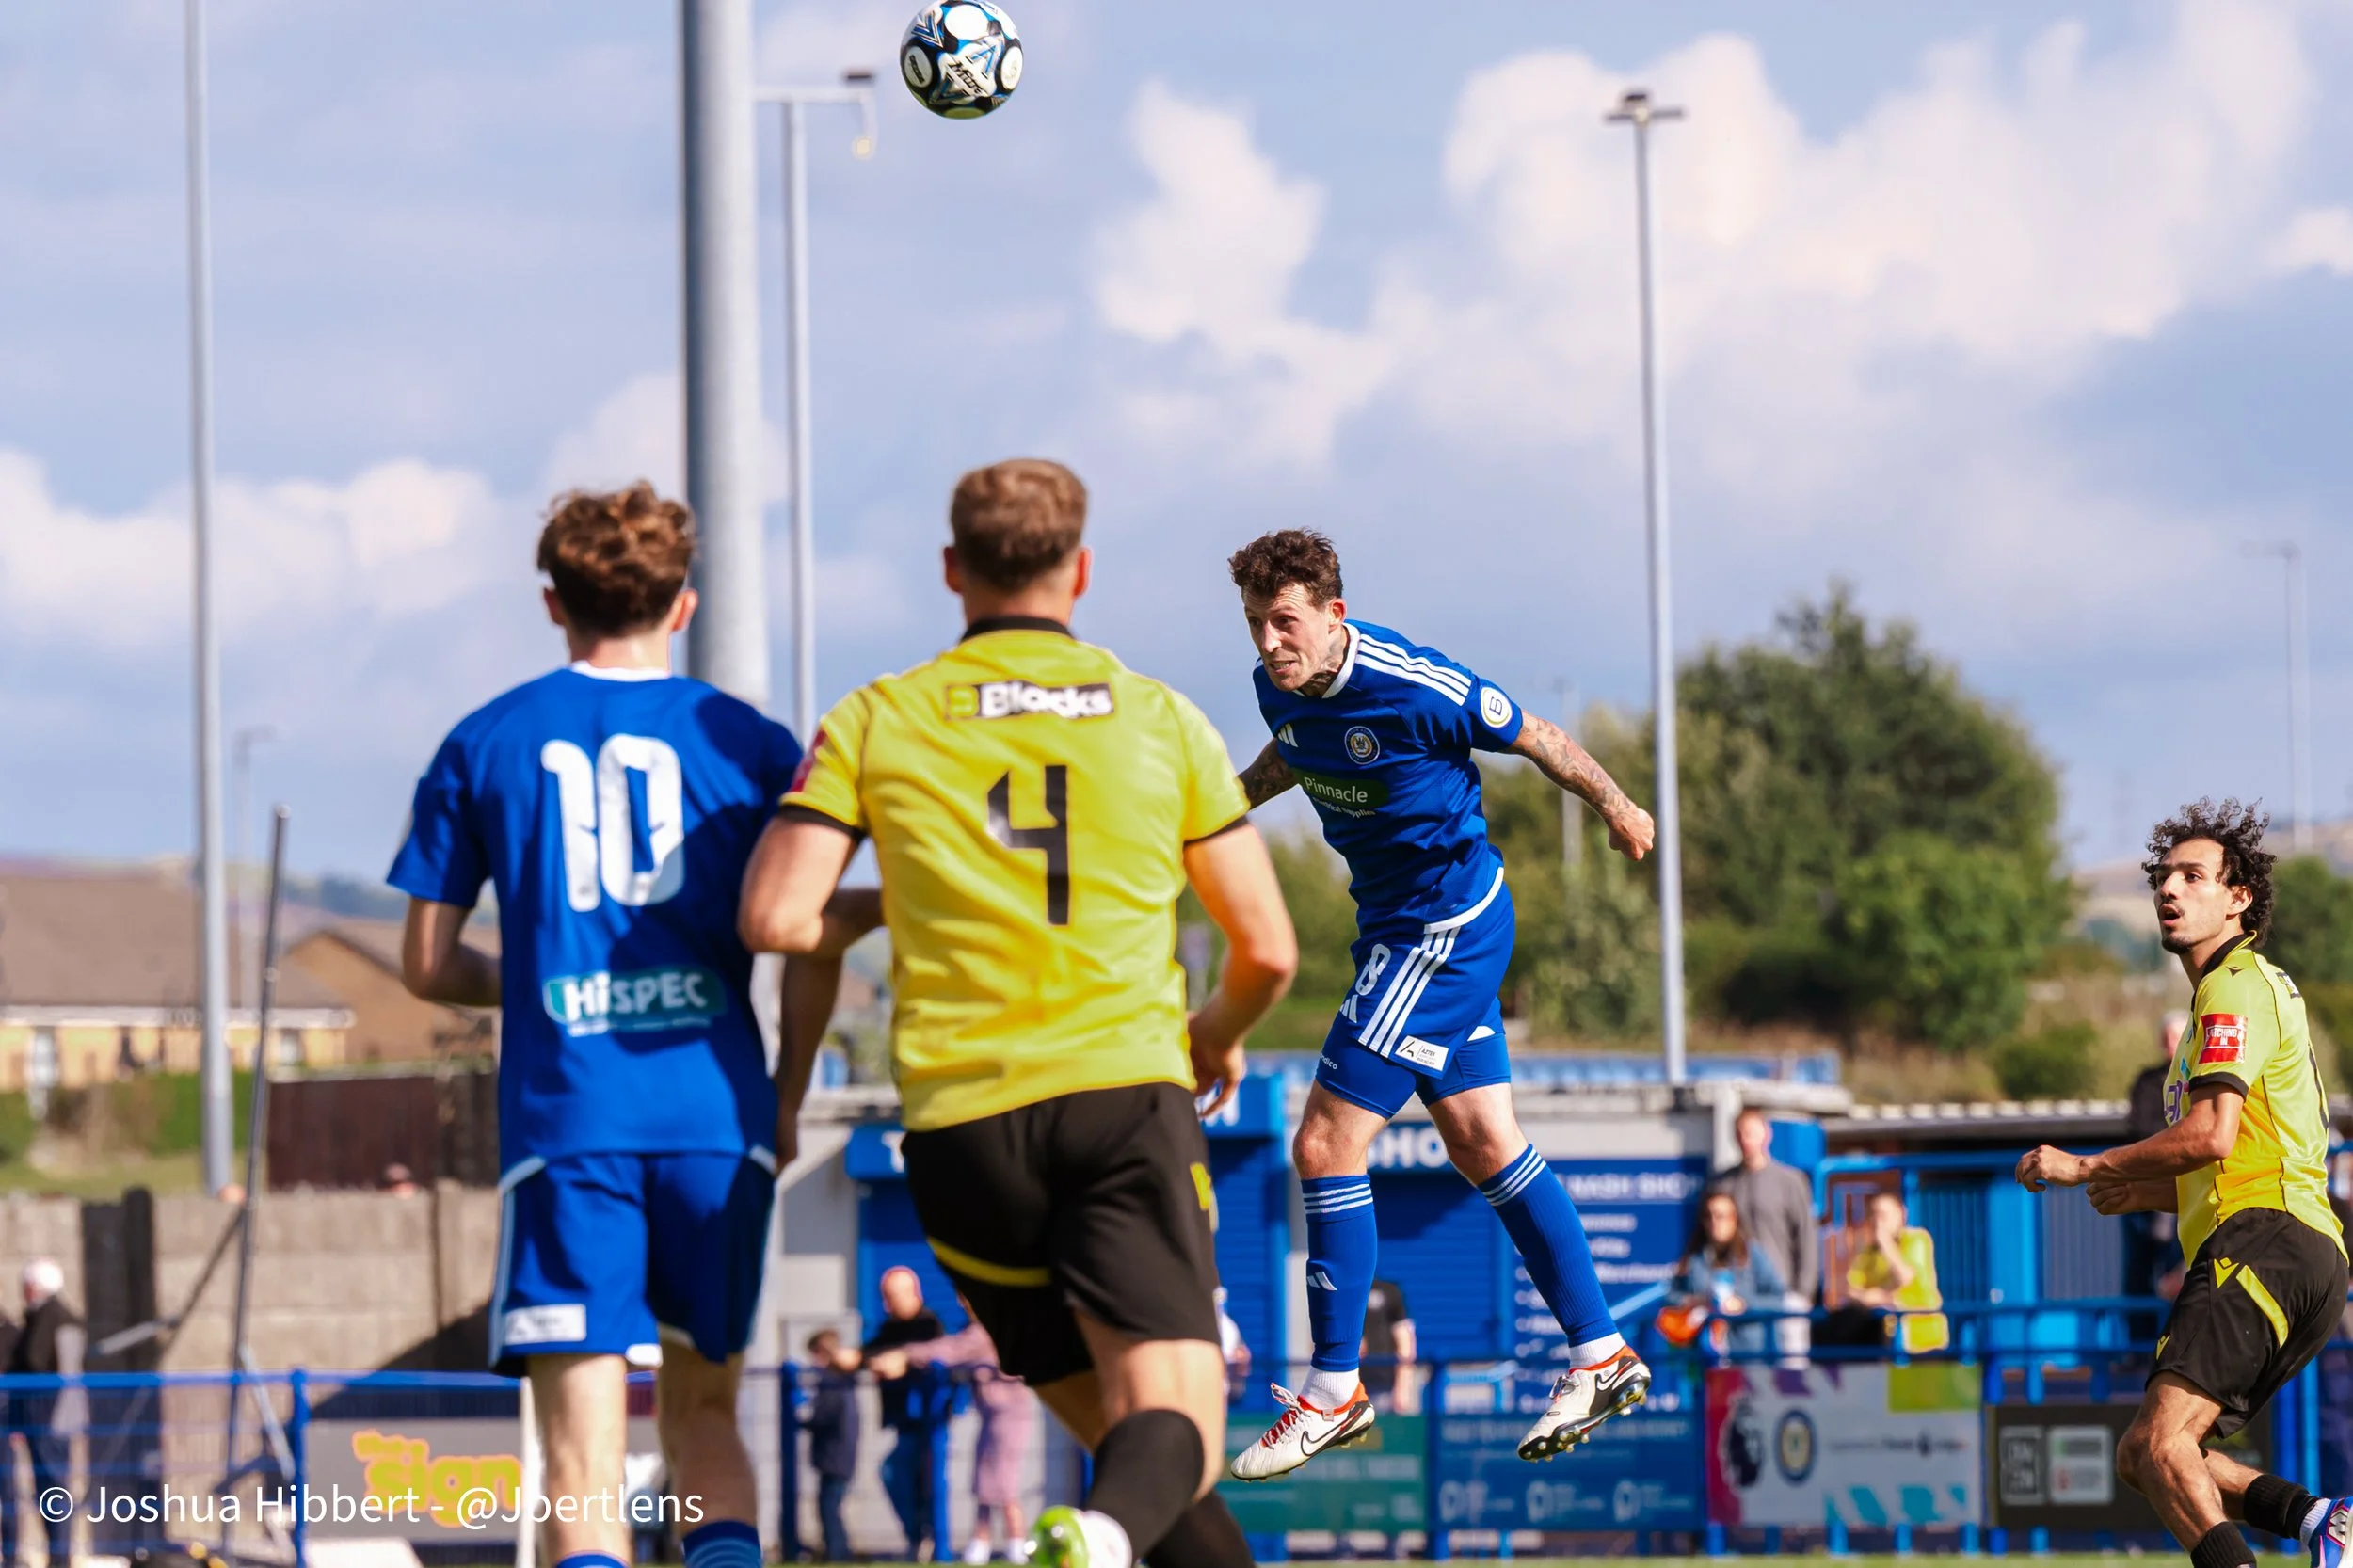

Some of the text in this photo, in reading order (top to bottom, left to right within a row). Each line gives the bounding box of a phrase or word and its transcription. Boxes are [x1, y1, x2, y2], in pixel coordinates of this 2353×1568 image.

[981, 680, 1113, 718] Blocks
[1304, 776, 1369, 803] Pinnacle
[540, 732, 684, 913] 10
[985, 764, 1069, 926] 4
[1355, 943, 1391, 997] 8
